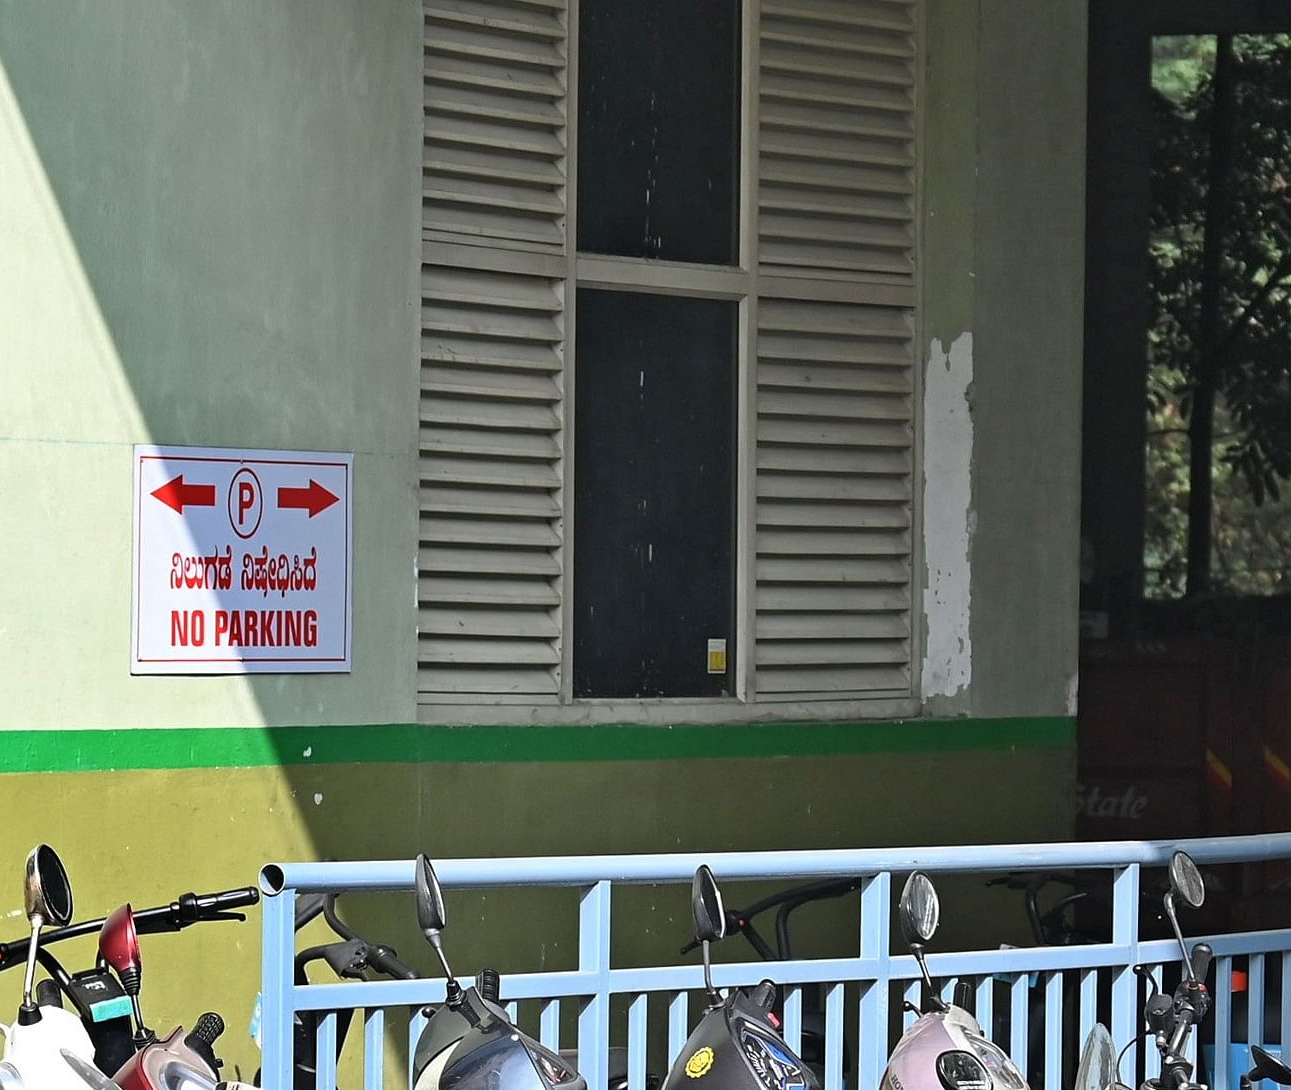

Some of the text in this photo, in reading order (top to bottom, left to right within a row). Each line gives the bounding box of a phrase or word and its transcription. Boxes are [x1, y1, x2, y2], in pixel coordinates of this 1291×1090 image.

[239, 482, 255, 525] P
[171, 610, 318, 647] NO PARKING
